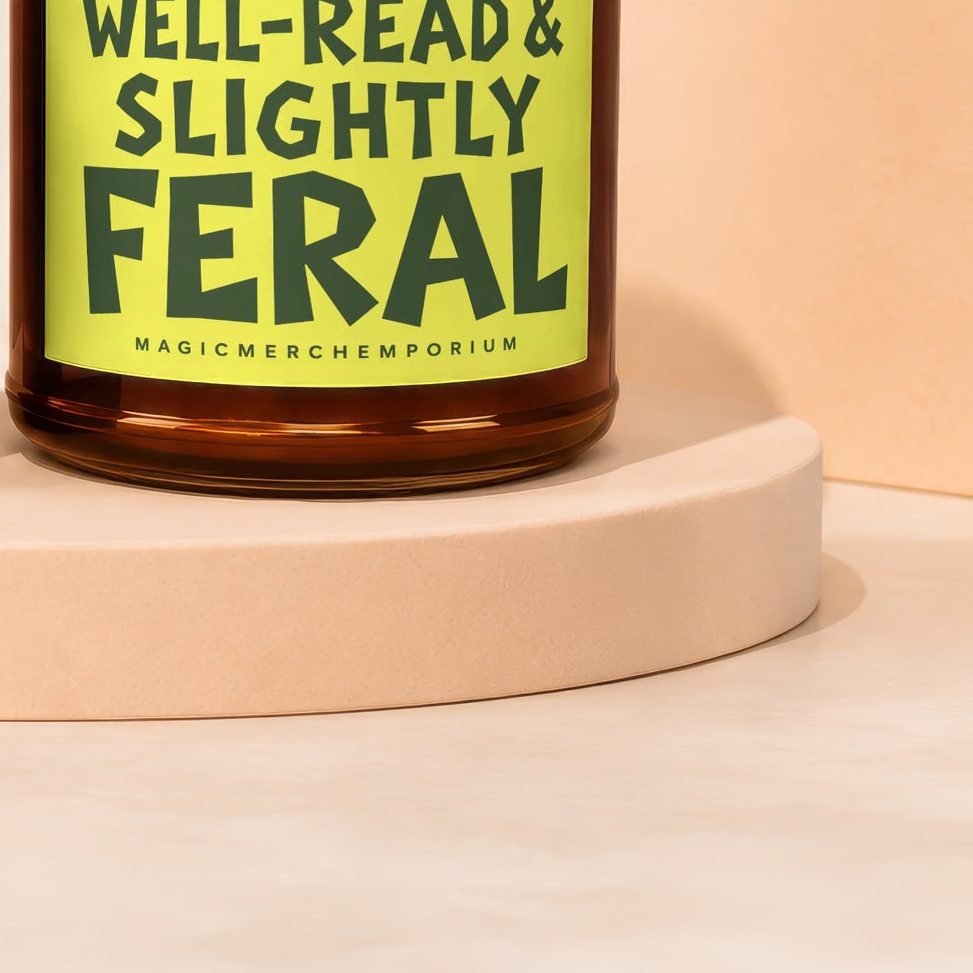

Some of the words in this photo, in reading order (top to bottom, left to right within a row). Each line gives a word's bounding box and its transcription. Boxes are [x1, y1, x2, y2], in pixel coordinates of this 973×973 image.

[114, 72, 541, 161] SLIGHTLY
[83, 165, 569, 328] FERAL
[134, 336, 518, 360] MAGICMERCHEMPORIUM
